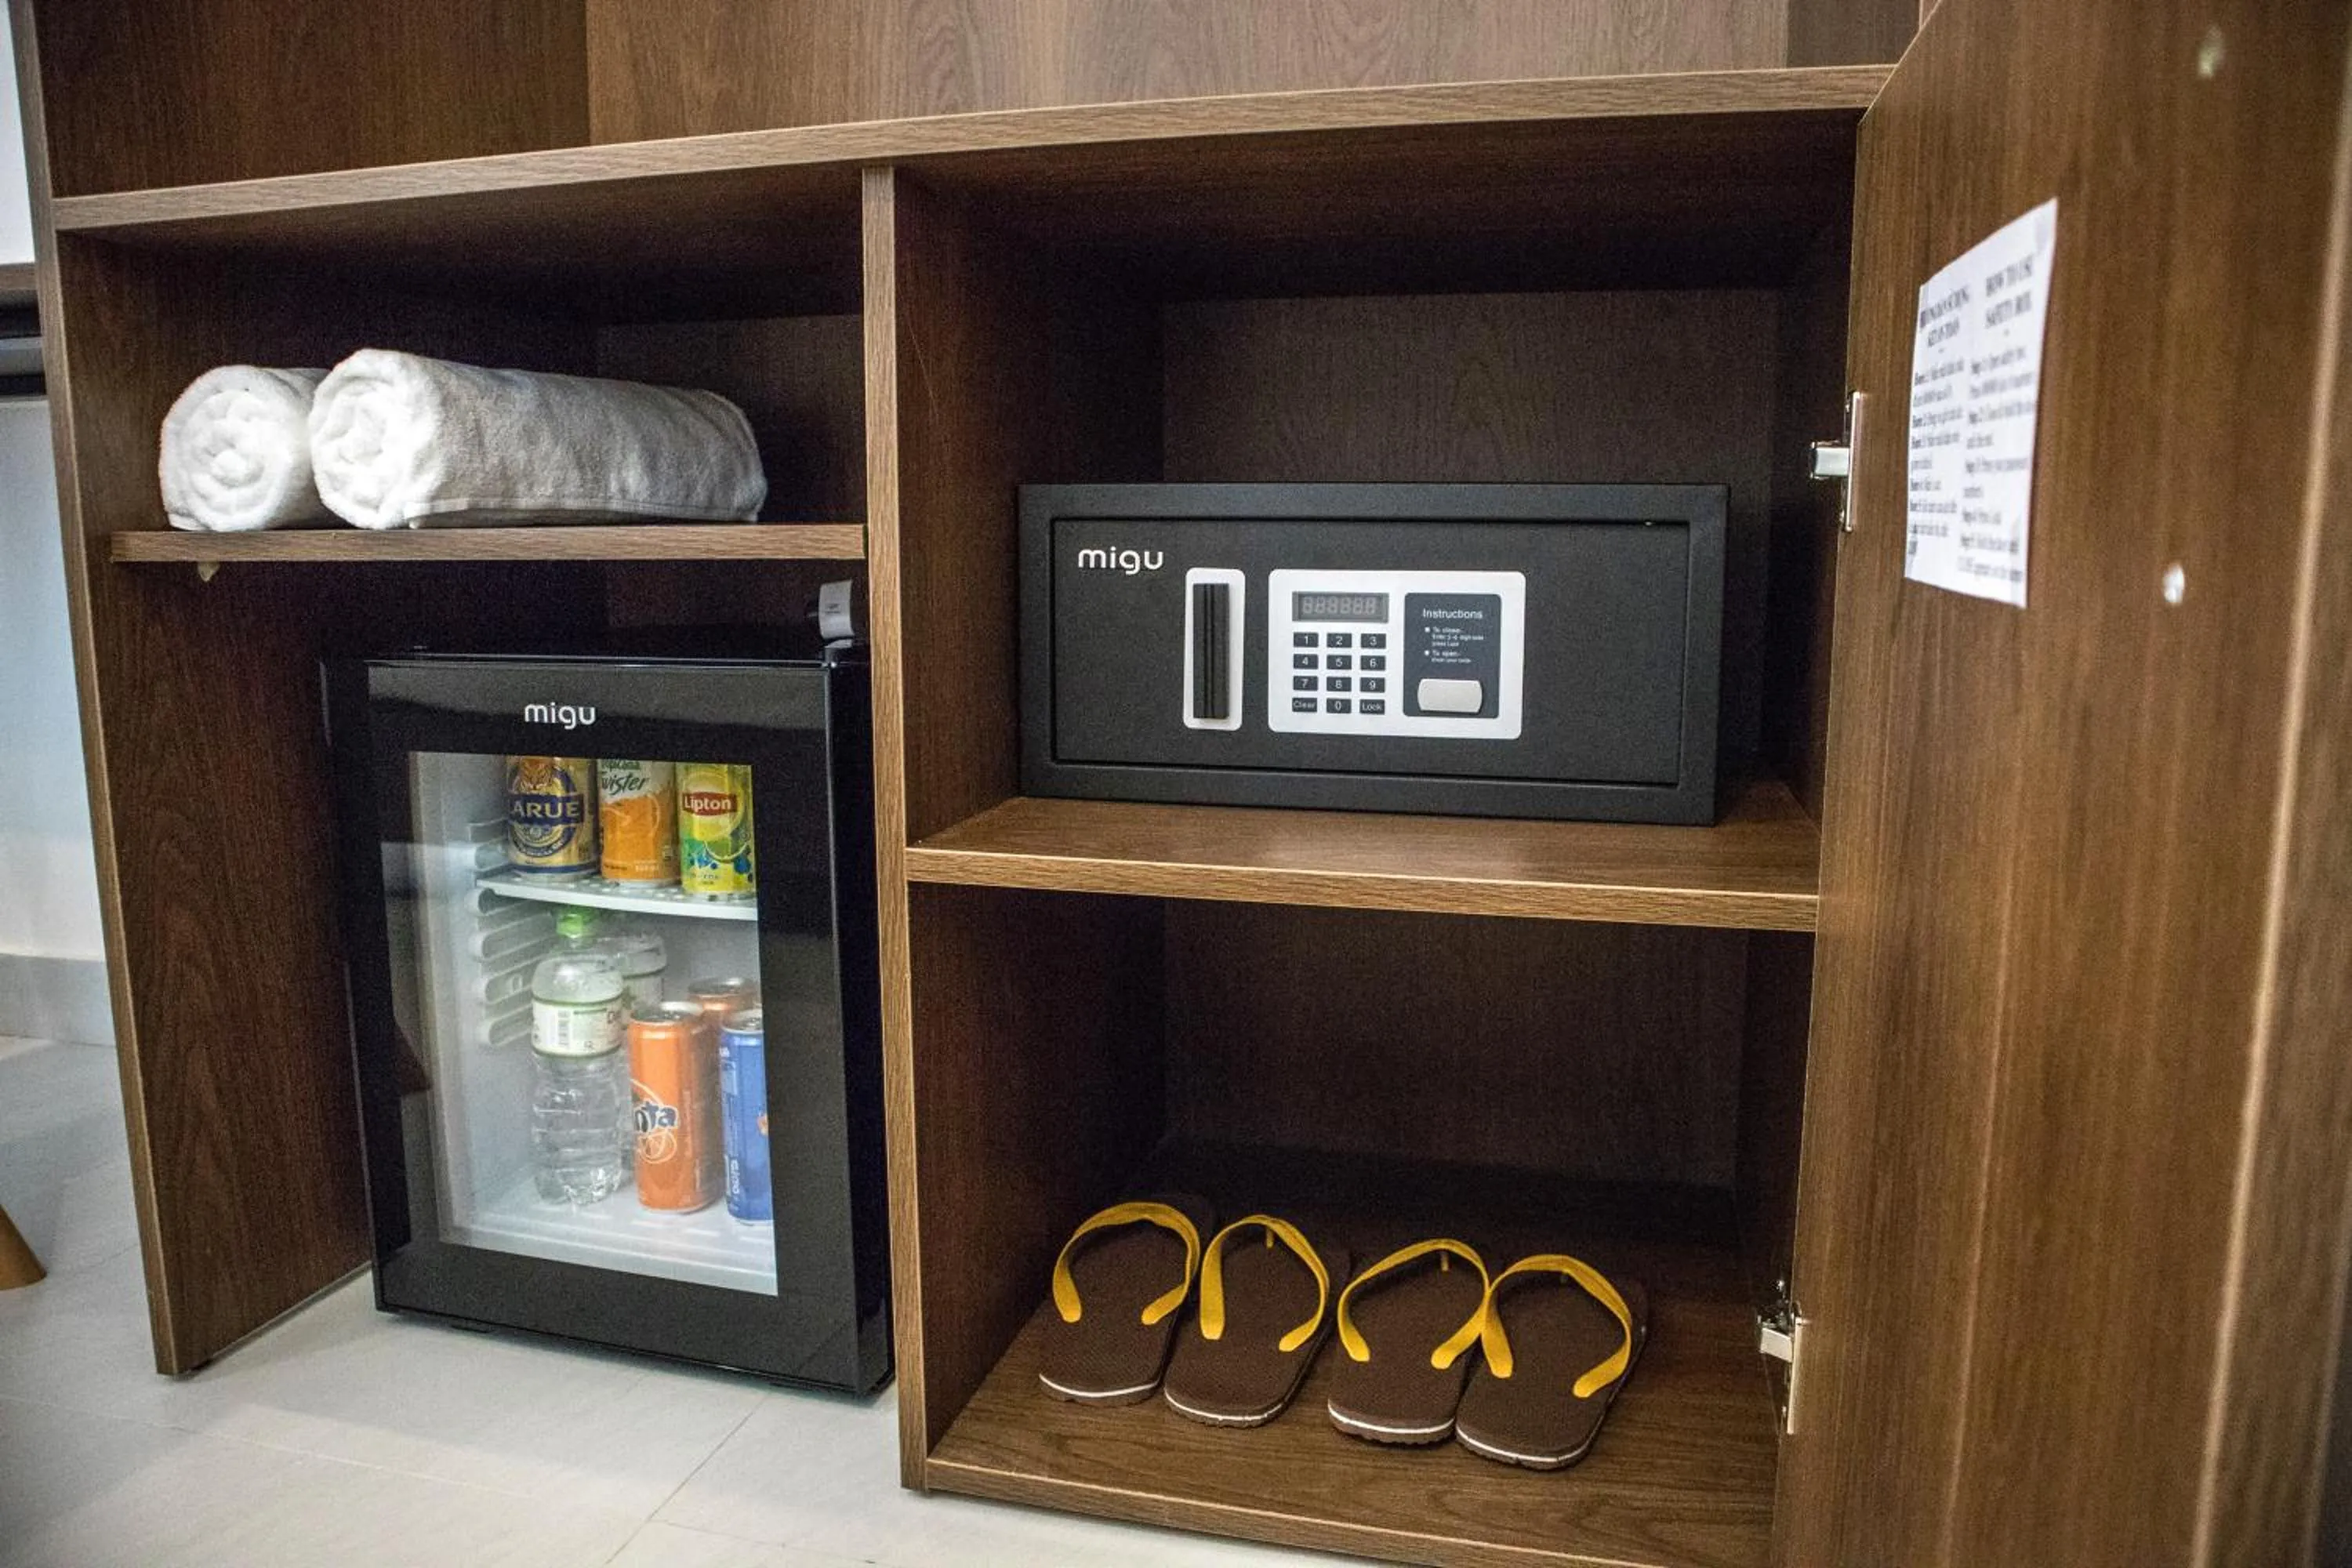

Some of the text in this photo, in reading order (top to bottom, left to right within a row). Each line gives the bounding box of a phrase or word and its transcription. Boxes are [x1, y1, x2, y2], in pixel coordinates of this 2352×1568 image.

[1078, 546, 1164, 575] migu
[1423, 608, 1483, 619] Instructions
[1304, 636, 1377, 645] 1 2 3
[1335, 658, 1343, 666] 5
[1370, 659, 1377, 667] 6
[1301, 679, 1376, 690] 7 8 9
[1293, 700, 1382, 710] Clear 0 Lock
[524, 702, 596, 730] migu
[510, 800, 580, 818] ARUE
[684, 795, 732, 813] Lipton
[634, 1100, 677, 1133] nta
